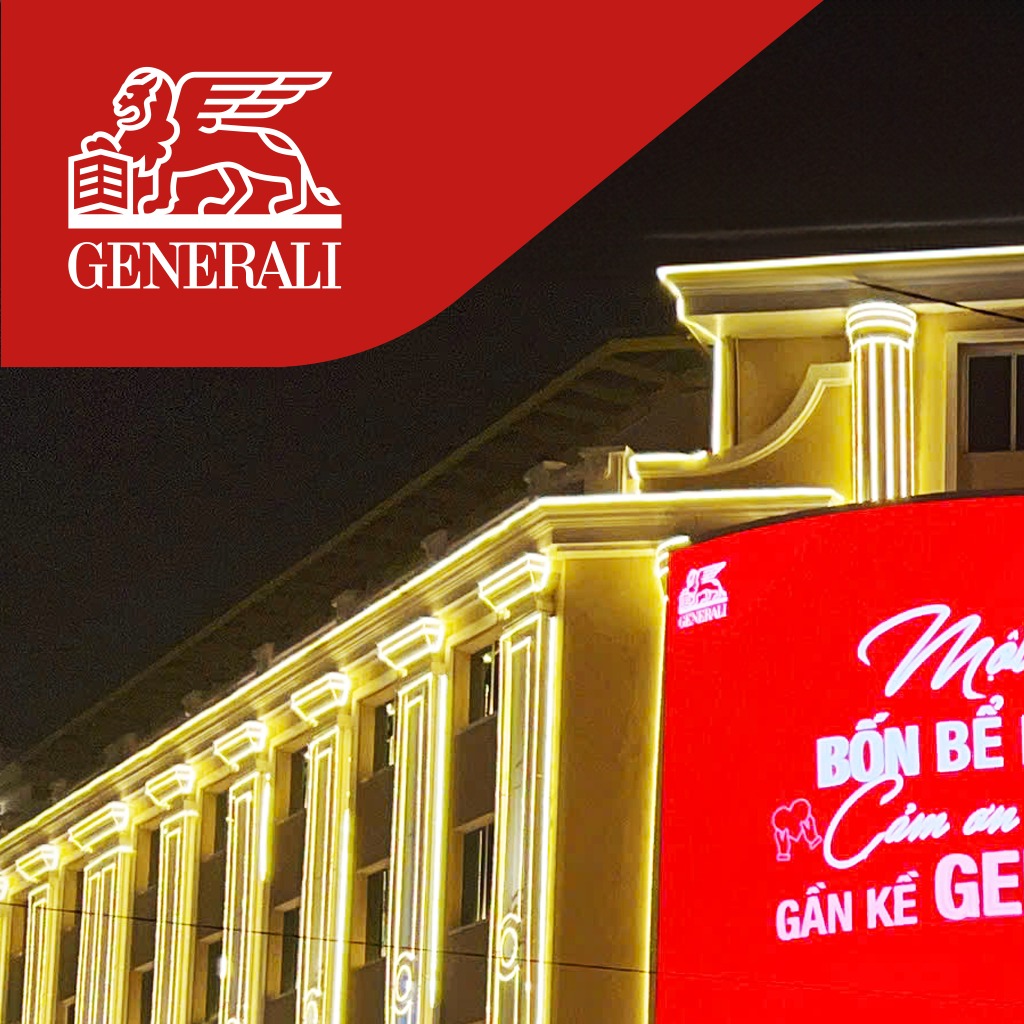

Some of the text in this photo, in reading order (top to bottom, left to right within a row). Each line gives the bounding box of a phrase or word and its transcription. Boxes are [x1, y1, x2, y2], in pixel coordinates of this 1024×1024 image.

[677, 603, 728, 629] GENERALI
[816, 711, 920, 789] BỐN
[936, 695, 1004, 773] BỂ
[823, 773, 951, 870] Cảm
[776, 881, 853, 941] GẦN
[866, 870, 920, 929] KỀ
